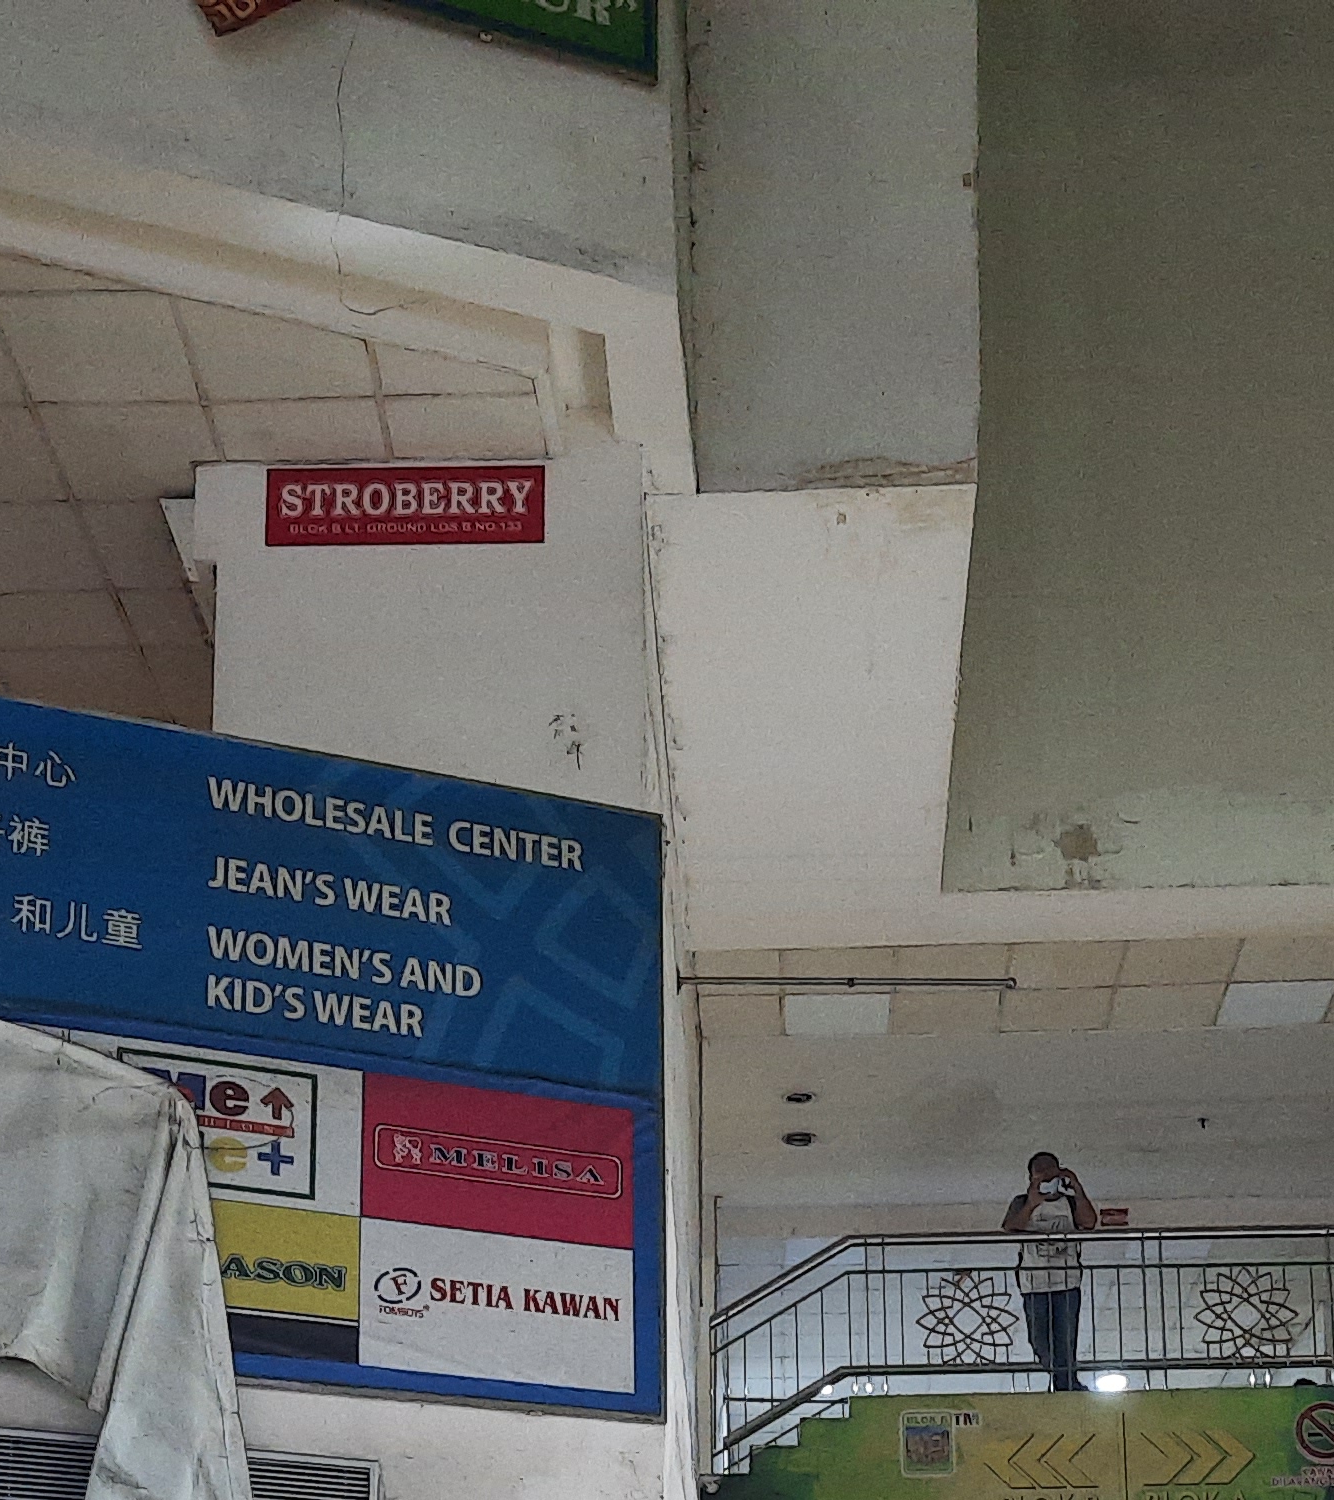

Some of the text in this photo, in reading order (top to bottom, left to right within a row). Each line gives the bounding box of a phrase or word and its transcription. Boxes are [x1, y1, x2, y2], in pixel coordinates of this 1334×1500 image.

[280, 480, 535, 518] STROBERRY
[367, 522, 427, 533] GROUND
[207, 775, 584, 872] WHOLESALE CENTER
[207, 856, 452, 926] JEAN'S WEAR
[11, 894, 143, 950] 和儿童
[207, 925, 482, 998] WOMEN'S AND
[206, 974, 424, 1038] KID'S WEAR
[430, 1144, 605, 1185] MELISA
[430, 1277, 514, 1310] SETIA
[523, 1288, 621, 1322] KAWAN
